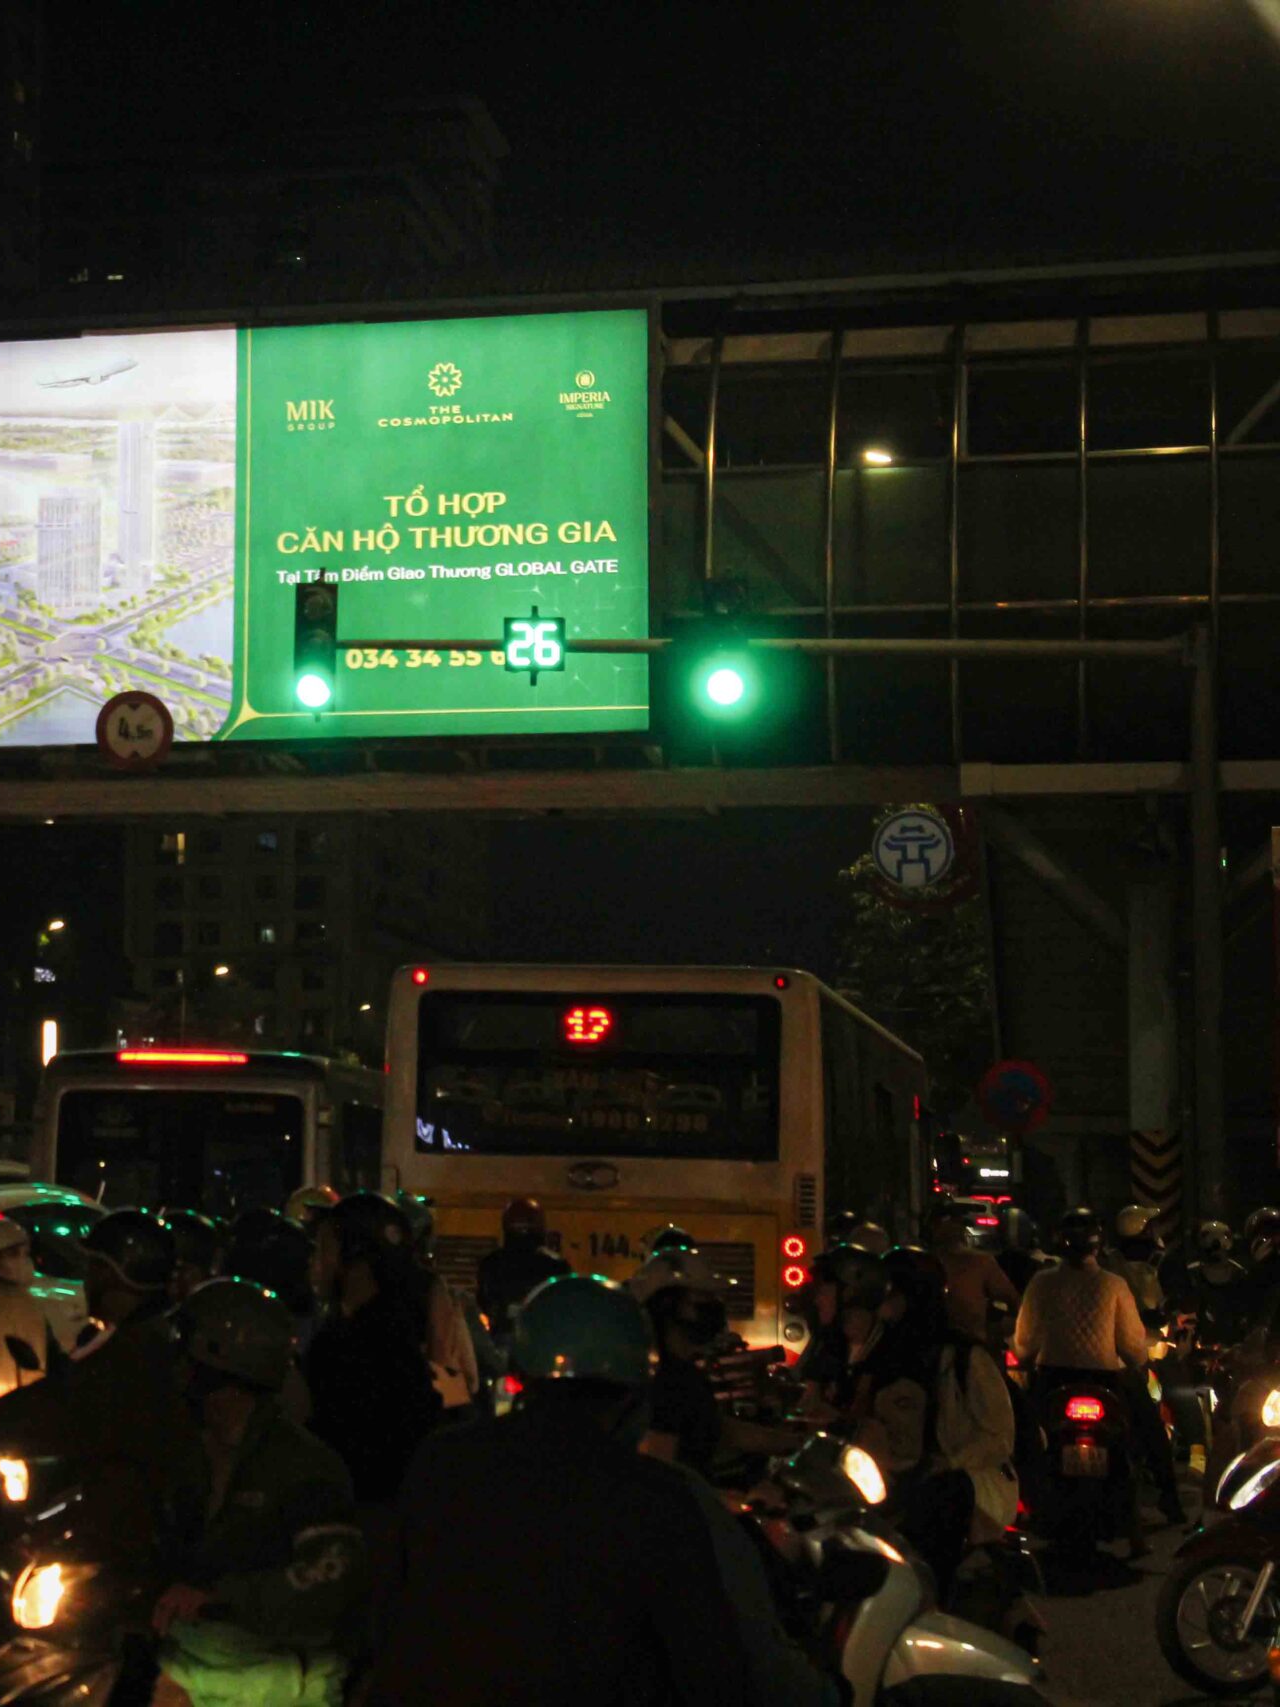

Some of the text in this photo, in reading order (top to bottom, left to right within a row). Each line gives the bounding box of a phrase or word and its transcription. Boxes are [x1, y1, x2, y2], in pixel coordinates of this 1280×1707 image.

[558, 391, 611, 404] IMPERIA
[286, 399, 335, 422] MIK
[377, 413, 513, 428] COSMOPOLITAN
[429, 405, 461, 414] THE
[287, 422, 335, 432] GROUP
[383, 484, 507, 518] TỔ HỢP
[276, 520, 617, 554] CĂN HỘ THƯƠNG GIA
[276, 570, 301, 586] Tại
[342, 565, 384, 582] Điểm
[387, 565, 426, 581] Giao
[429, 564, 492, 580] Thương
[495, 560, 567, 577] GLOBAL
[570, 558, 619, 575] GATE
[507, 621, 562, 667] 26
[345, 648, 399, 669] 034
[405, 648, 442, 668] 34
[449, 648, 483, 667] 55
